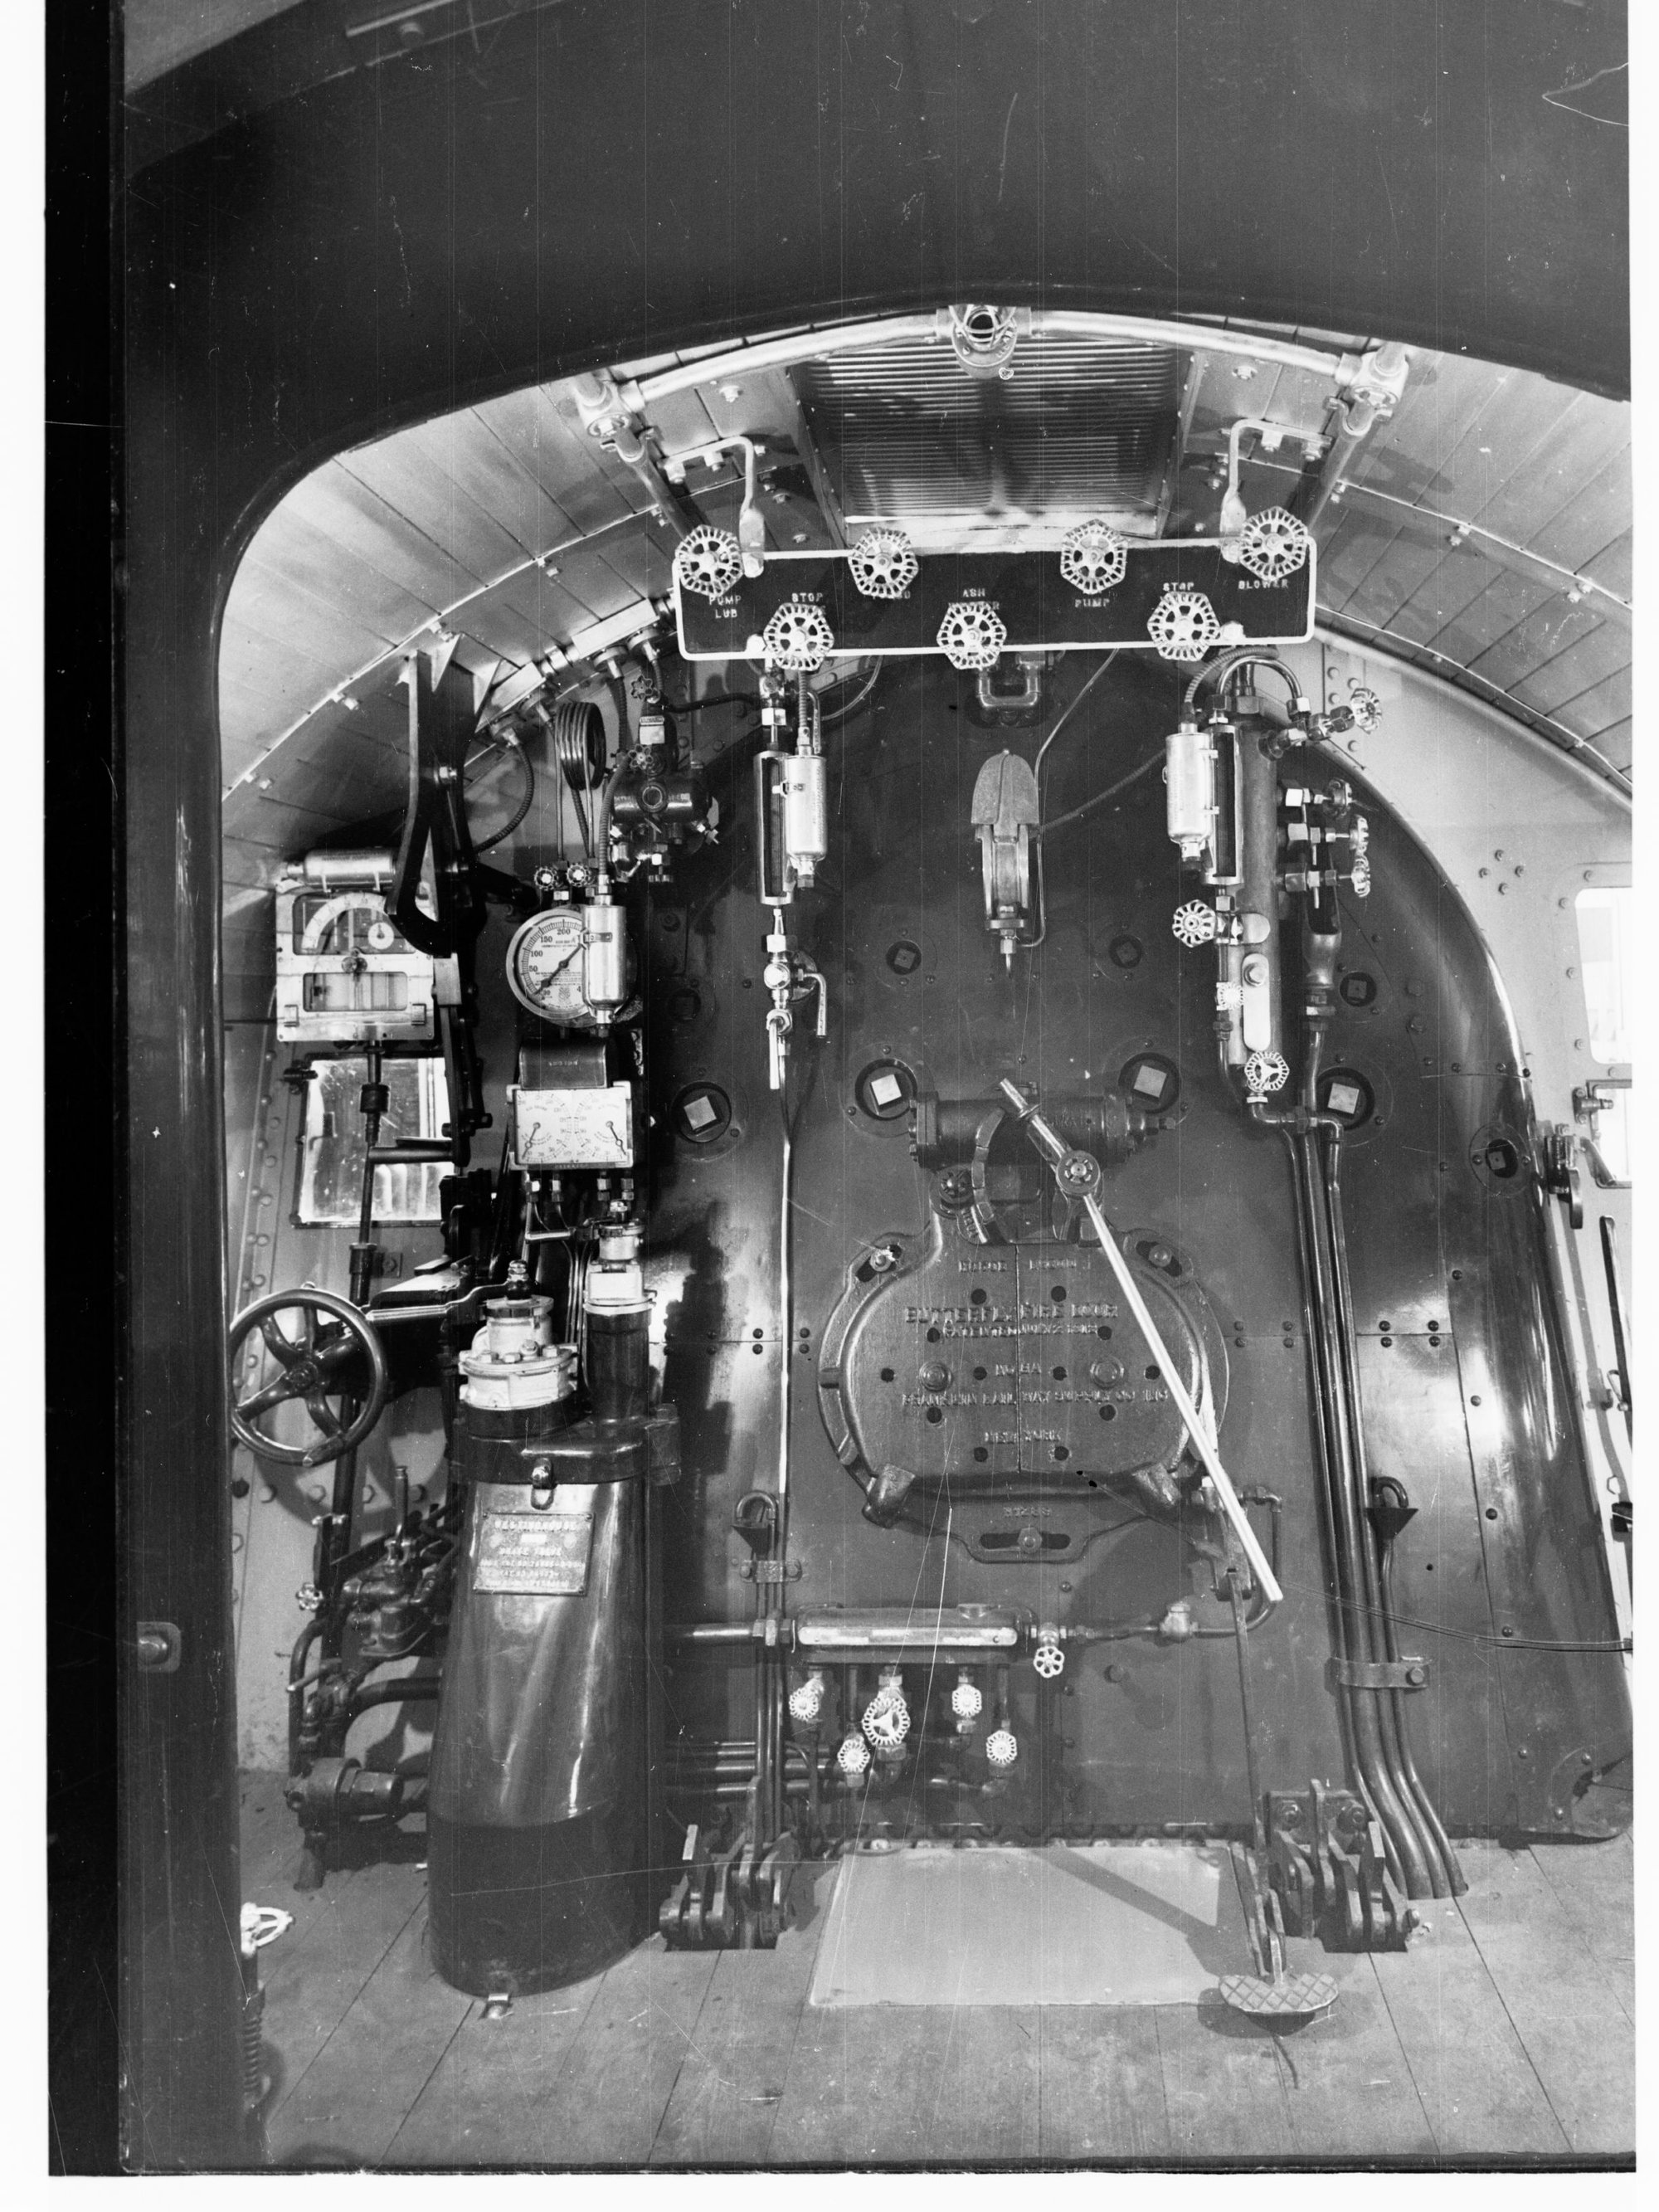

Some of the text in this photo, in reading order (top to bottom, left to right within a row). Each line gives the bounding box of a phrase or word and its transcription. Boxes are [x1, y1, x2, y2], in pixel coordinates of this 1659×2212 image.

[1162, 582, 1194, 592] STOP
[1238, 579, 1289, 590] BLOWER
[791, 592, 824, 602] STOP
[962, 588, 986, 597] ASH
[708, 595, 742, 606] PUMP
[1074, 598, 1110, 608] PUMP
[715, 609, 737, 619] LUB
